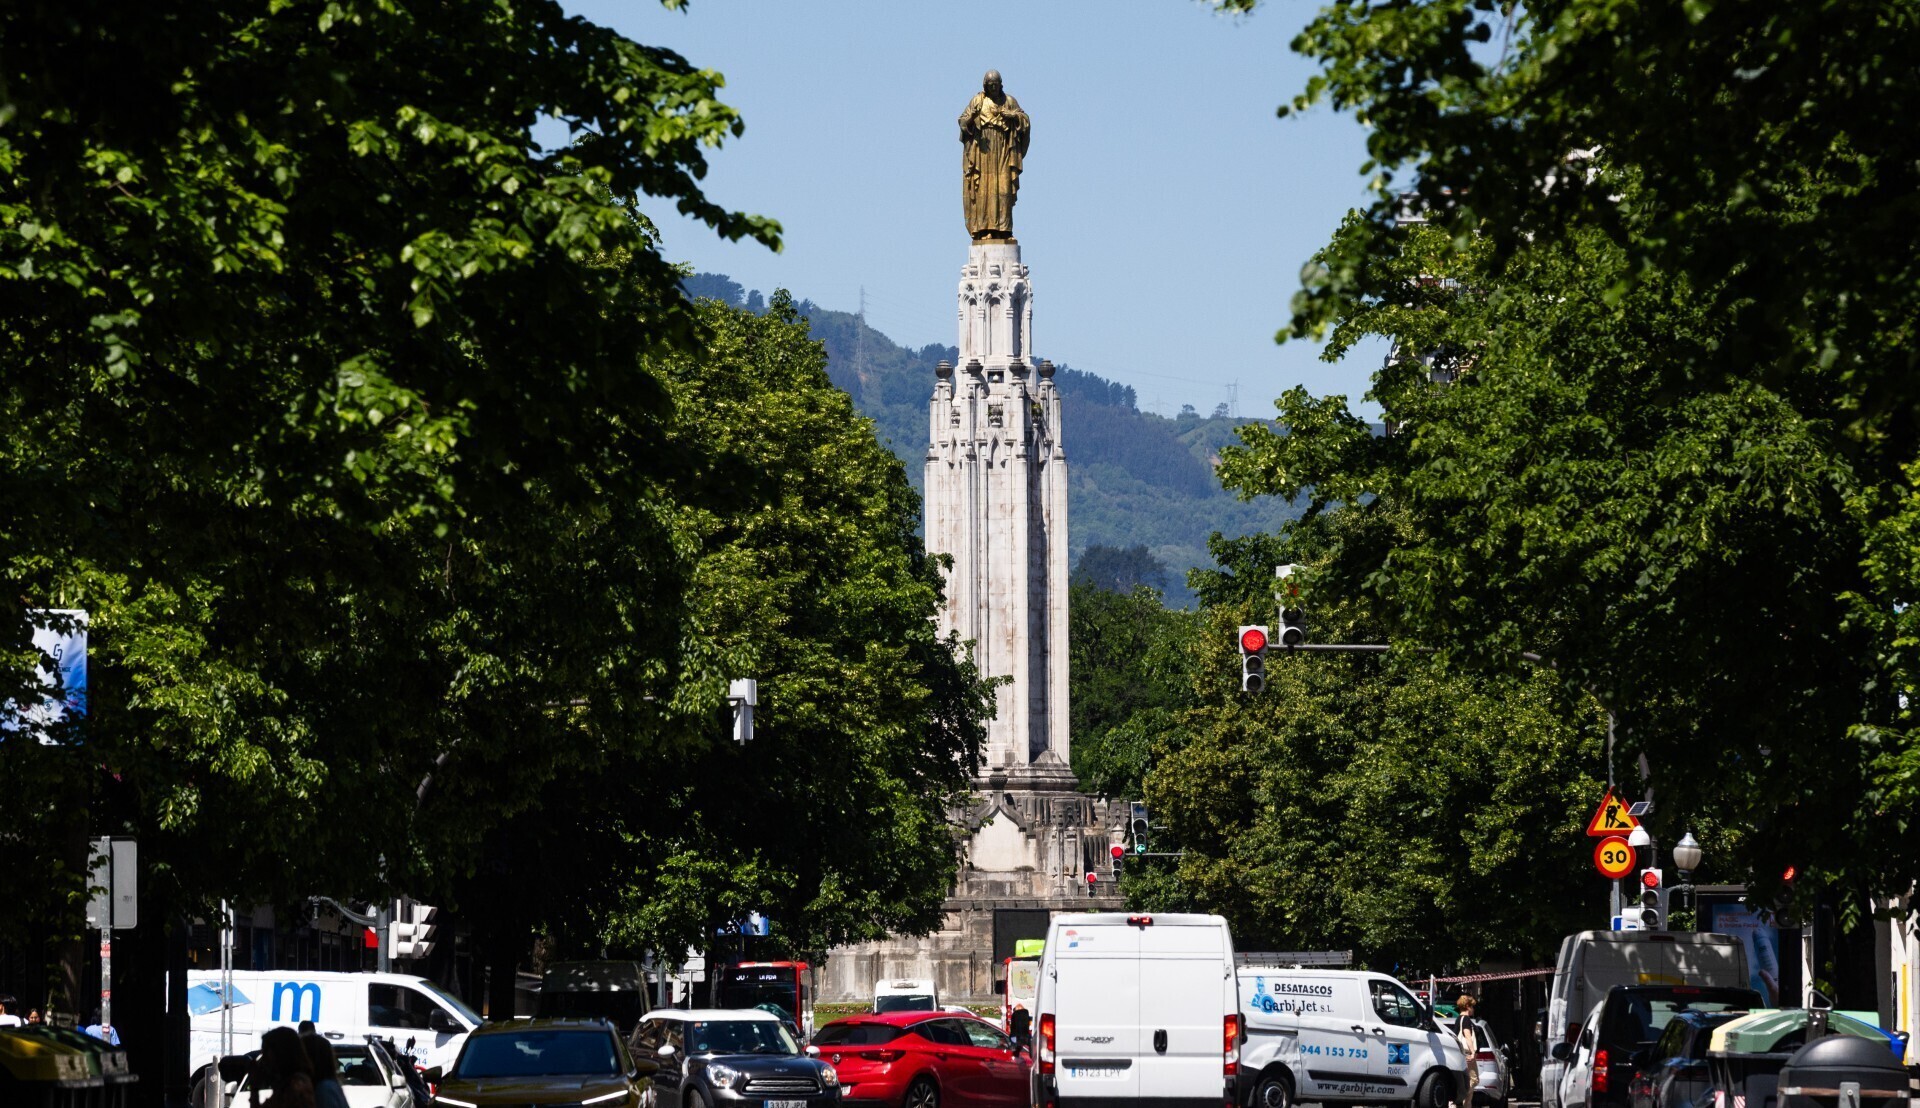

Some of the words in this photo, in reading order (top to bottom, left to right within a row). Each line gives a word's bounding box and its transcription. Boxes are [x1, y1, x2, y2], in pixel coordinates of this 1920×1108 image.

[1604, 850, 1627, 864] 30
[1274, 983, 1333, 995] DESATASCOS
[271, 981, 321, 1023] m
[1263, 999, 1295, 1012] Garbi
[1298, 1000, 1318, 1012] Jet
[1301, 1045, 1321, 1055] 944
[1325, 1047, 1344, 1057] 153
[1348, 1048, 1368, 1059] 753
[1317, 1082, 1395, 1095] www.garbijet.com
